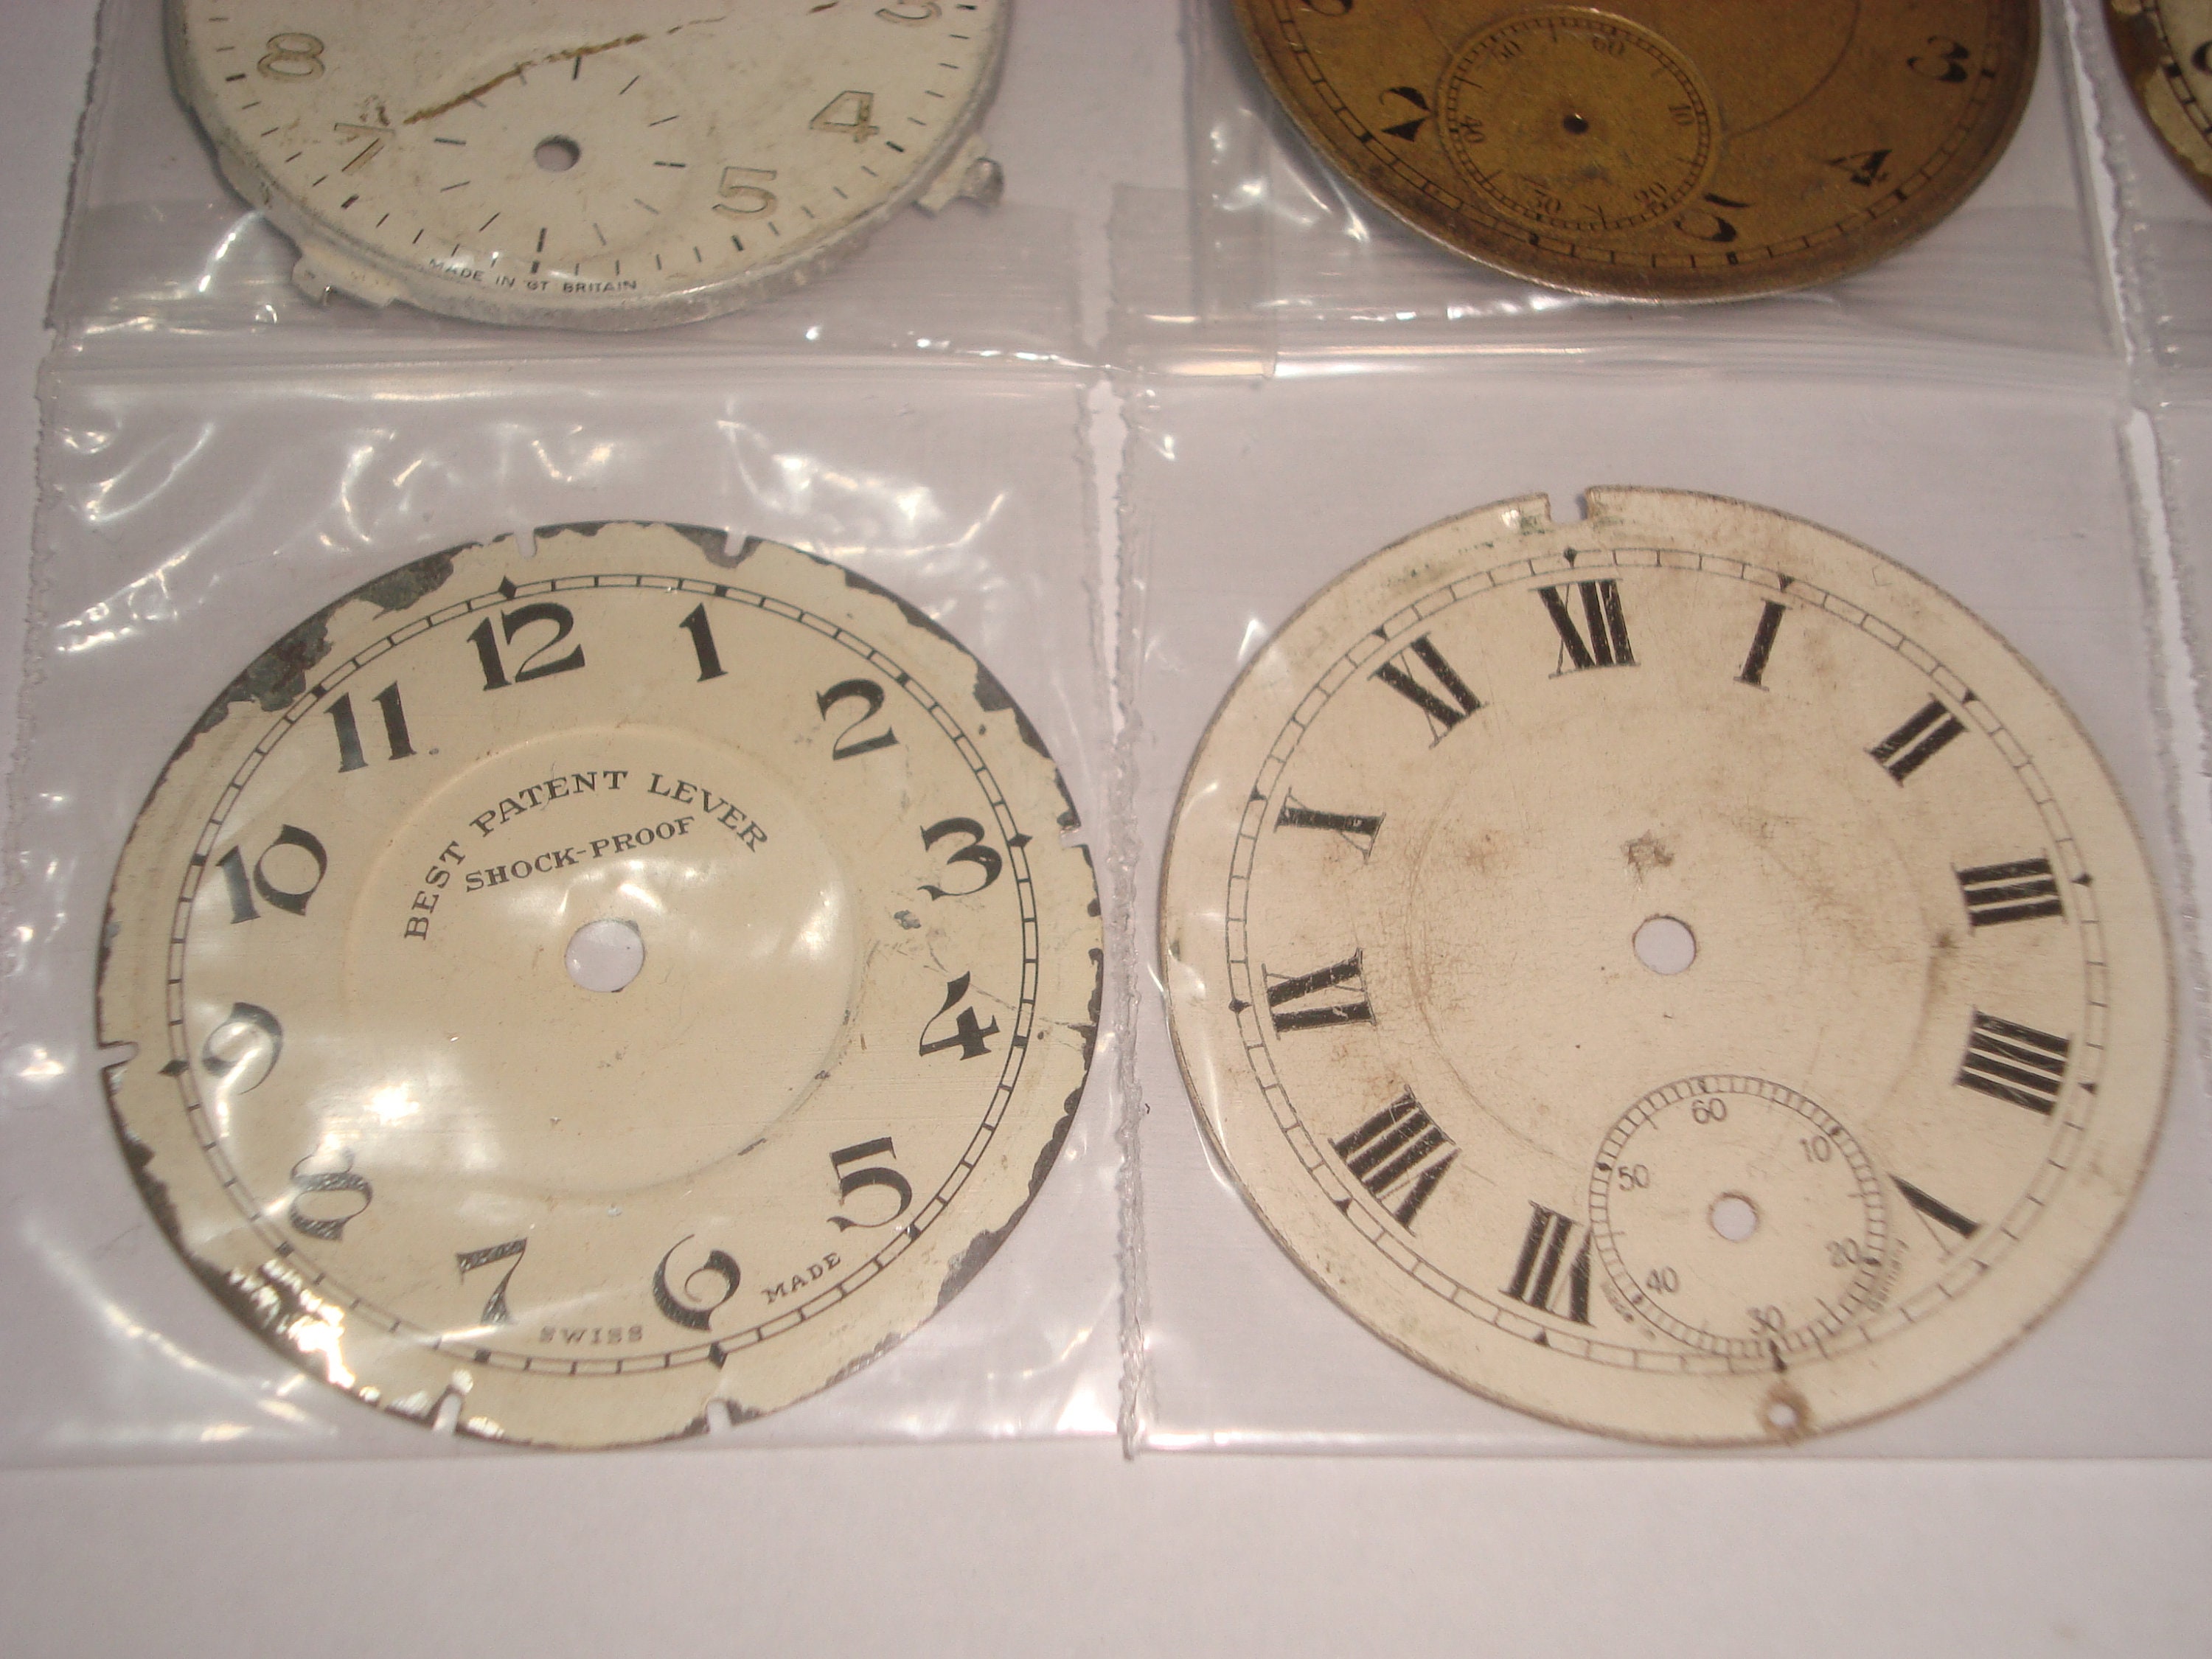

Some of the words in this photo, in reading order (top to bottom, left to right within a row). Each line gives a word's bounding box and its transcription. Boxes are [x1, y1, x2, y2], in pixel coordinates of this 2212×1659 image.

[257, 32, 326, 77] 8
[333, 122, 396, 176] 7
[810, 89, 880, 143] 4
[712, 166, 778, 220] 5
[428, 258, 485, 282] MADE
[495, 275, 516, 288] IN
[563, 279, 638, 294] BRITAIN
[467, 602, 585, 691] 12
[679, 602, 728, 683] 1
[1528, 578, 1641, 679] XII
[1733, 597, 1792, 692] I
[324, 681, 417, 773] 11
[816, 678, 900, 761] 2
[1367, 632, 1490, 749] XI
[1863, 692, 1969, 788] II
[216, 824, 328, 925] 10
[404, 841, 466, 941] BEST
[469, 770, 628, 837] PATENT
[647, 773, 768, 852] LEVER
[465, 815, 695, 894] SHOCK-PROOF
[917, 817, 1003, 901] 3
[1950, 847, 2069, 936] III
[201, 1001, 284, 1095] 9
[919, 970, 1001, 1060] 4
[1691, 1096, 1728, 1124] 60
[1798, 1134, 1832, 1164] 10
[289, 1141, 373, 1241] 8
[827, 1136, 913, 1232] 5
[1618, 1163, 1651, 1192] 50
[456, 1237, 528, 1326] 7
[652, 1234, 741, 1331] 6
[761, 1251, 841, 1304] MADE
[1645, 1265, 1680, 1295] 40
